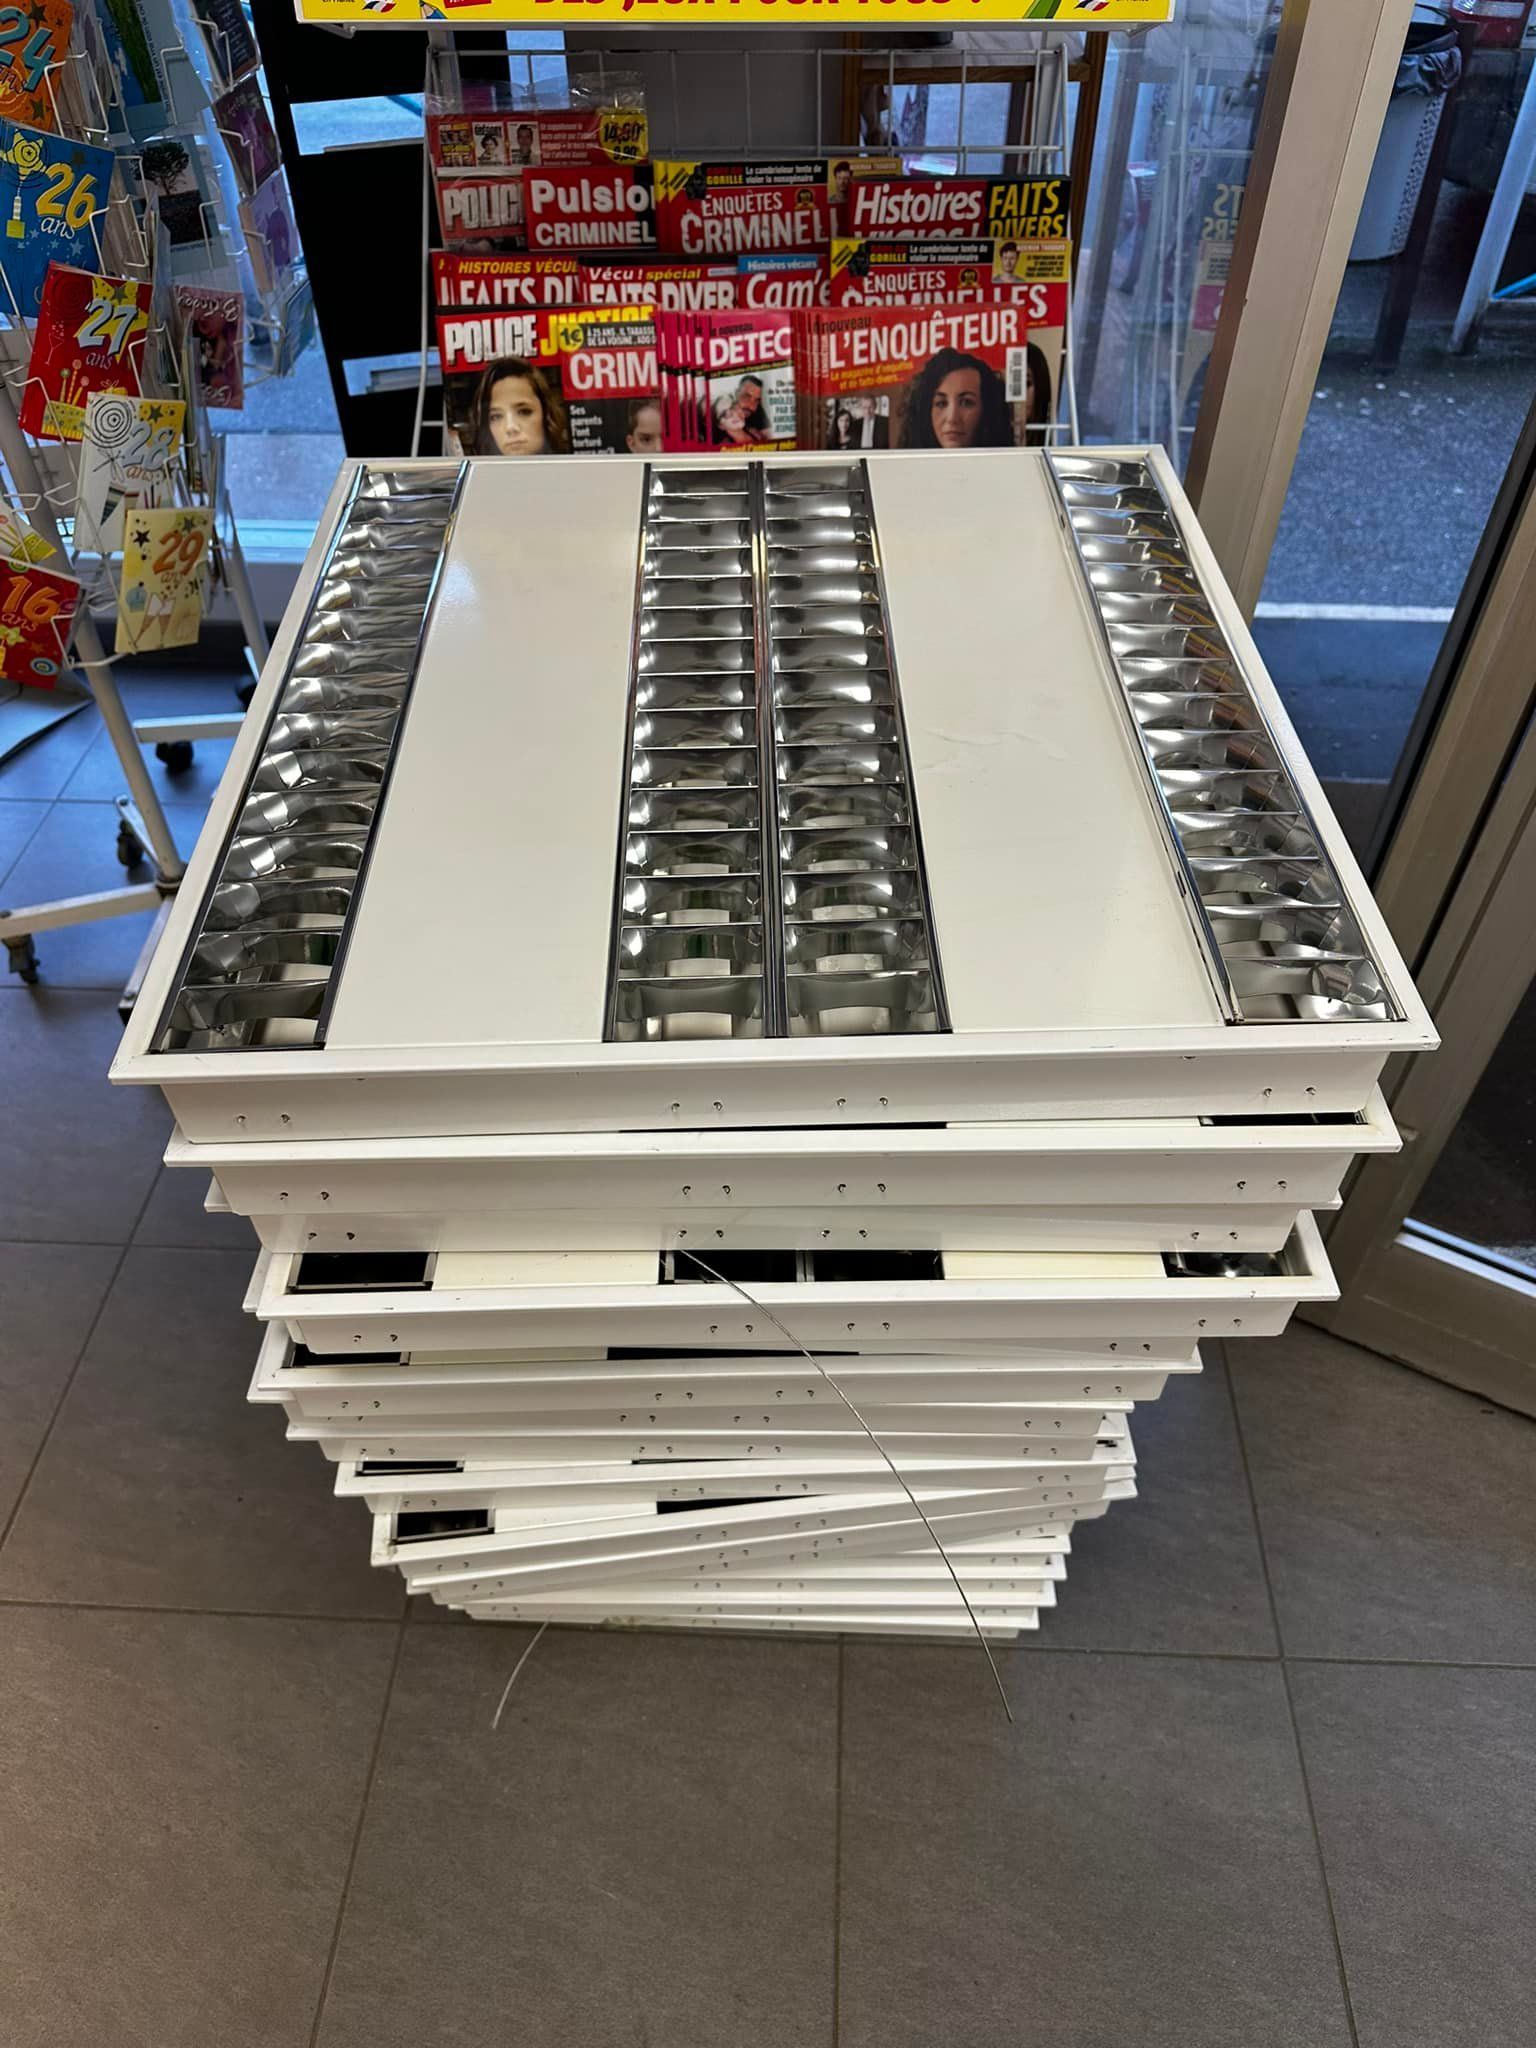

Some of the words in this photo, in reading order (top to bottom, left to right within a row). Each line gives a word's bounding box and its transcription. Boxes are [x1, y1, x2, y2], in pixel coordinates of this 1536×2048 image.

[0, 6, 56, 93] 24
[35, 162, 98, 230] 26
[530, 178, 655, 214] Pulsio
[701, 190, 783, 217] ENQUÊTES
[853, 181, 984, 225] Histoires
[988, 180, 1062, 219] FAITS
[40, 216, 77, 240] ans
[535, 220, 657, 246] CRIMINEL
[458, 260, 531, 275] HISTOIRES
[589, 266, 633, 281] Vécu
[638, 267, 644, 281] !
[646, 268, 702, 283] spécial
[863, 268, 946, 294] ENQUÊTES
[459, 276, 538, 305] FAITS
[76, 297, 139, 357] 27
[443, 313, 538, 366] POLICE
[560, 327, 582, 346] 1€
[828, 308, 1019, 369] L'ENQUÊTEUR
[85, 352, 115, 371] ans
[708, 326, 792, 368] DETEC
[569, 351, 658, 390] CRIM
[569, 405, 587, 416] Ses
[122, 421, 175, 472] 28
[126, 464, 155, 483] ans
[152, 529, 206, 576] 29
[160, 569, 184, 586] ans
[3, 575, 61, 620] 16
